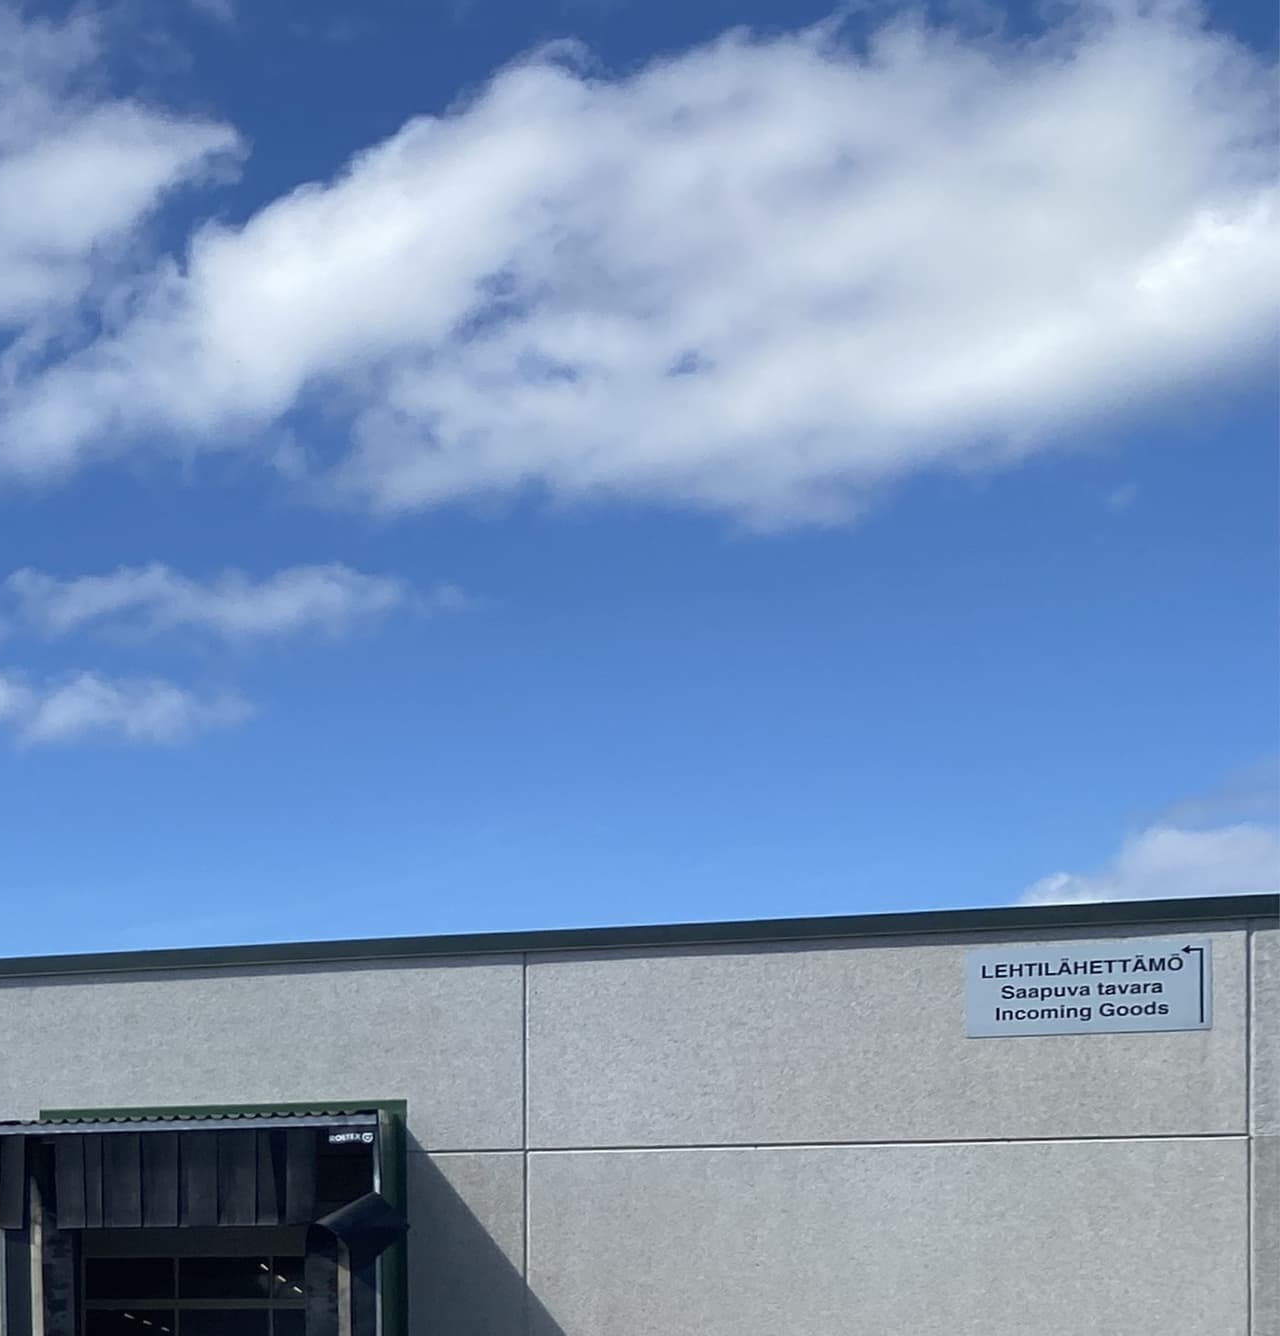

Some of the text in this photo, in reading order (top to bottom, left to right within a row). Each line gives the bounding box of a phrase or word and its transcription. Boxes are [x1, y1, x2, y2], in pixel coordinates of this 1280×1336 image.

[981, 953, 1184, 979] LEHTILÄHETTÄMÖ
[1001, 981, 1163, 1001] Saapuva tavara
[995, 1001, 1169, 1021] Incoming Goods
